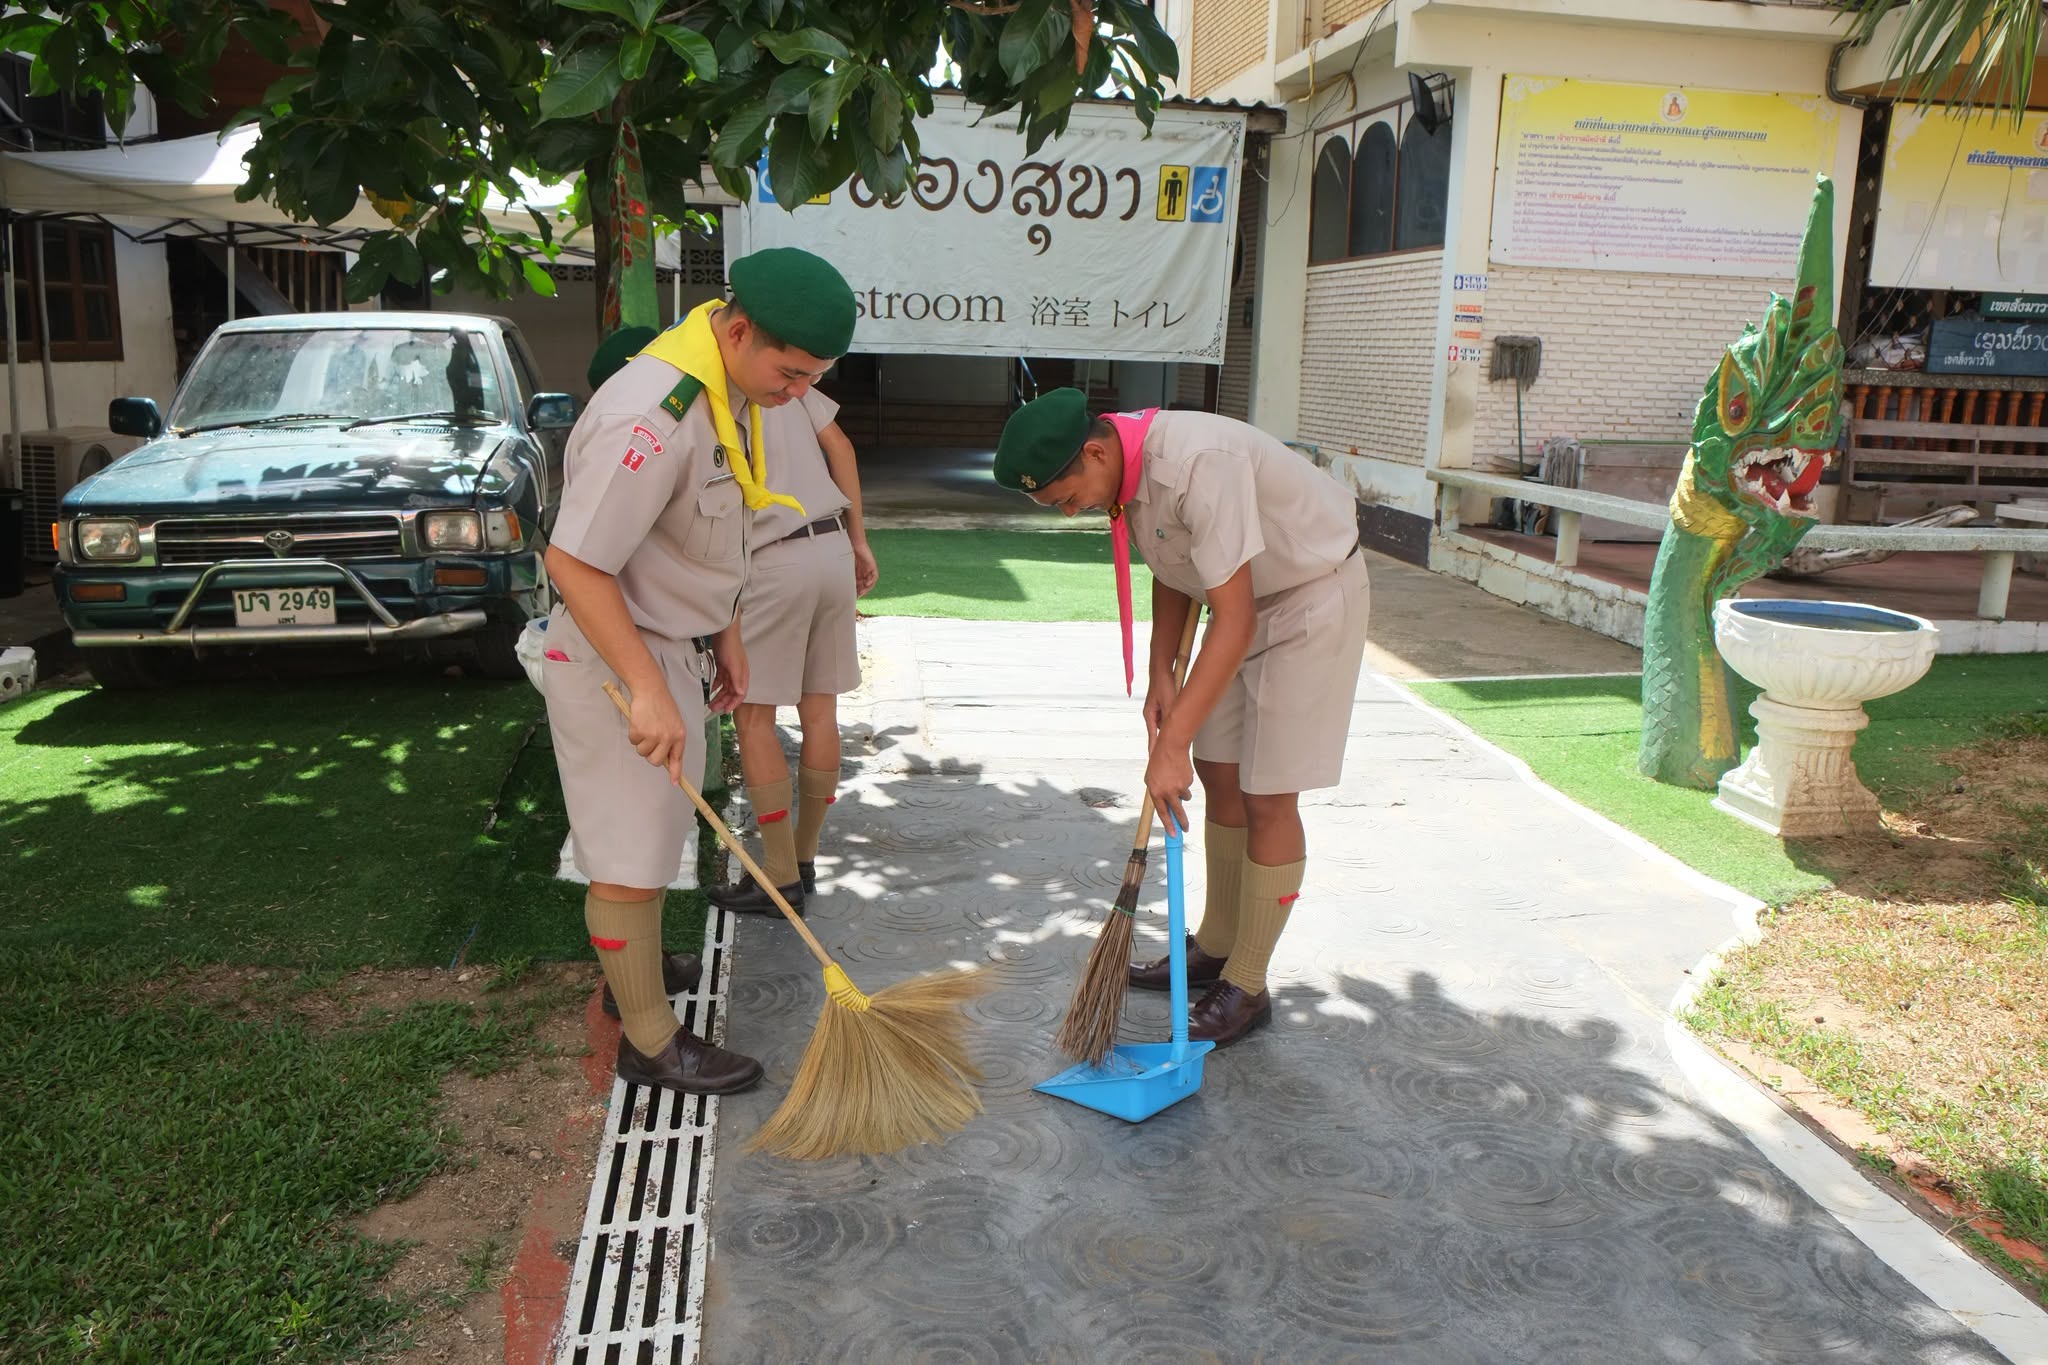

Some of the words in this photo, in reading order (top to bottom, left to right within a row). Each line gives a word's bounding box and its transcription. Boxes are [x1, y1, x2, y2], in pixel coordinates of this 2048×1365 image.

[854, 286, 1007, 323] stroom
[1031, 296, 1091, 327] 浴室
[1111, 299, 1187, 328] トイレ
[279, 590, 330, 610] 2949
